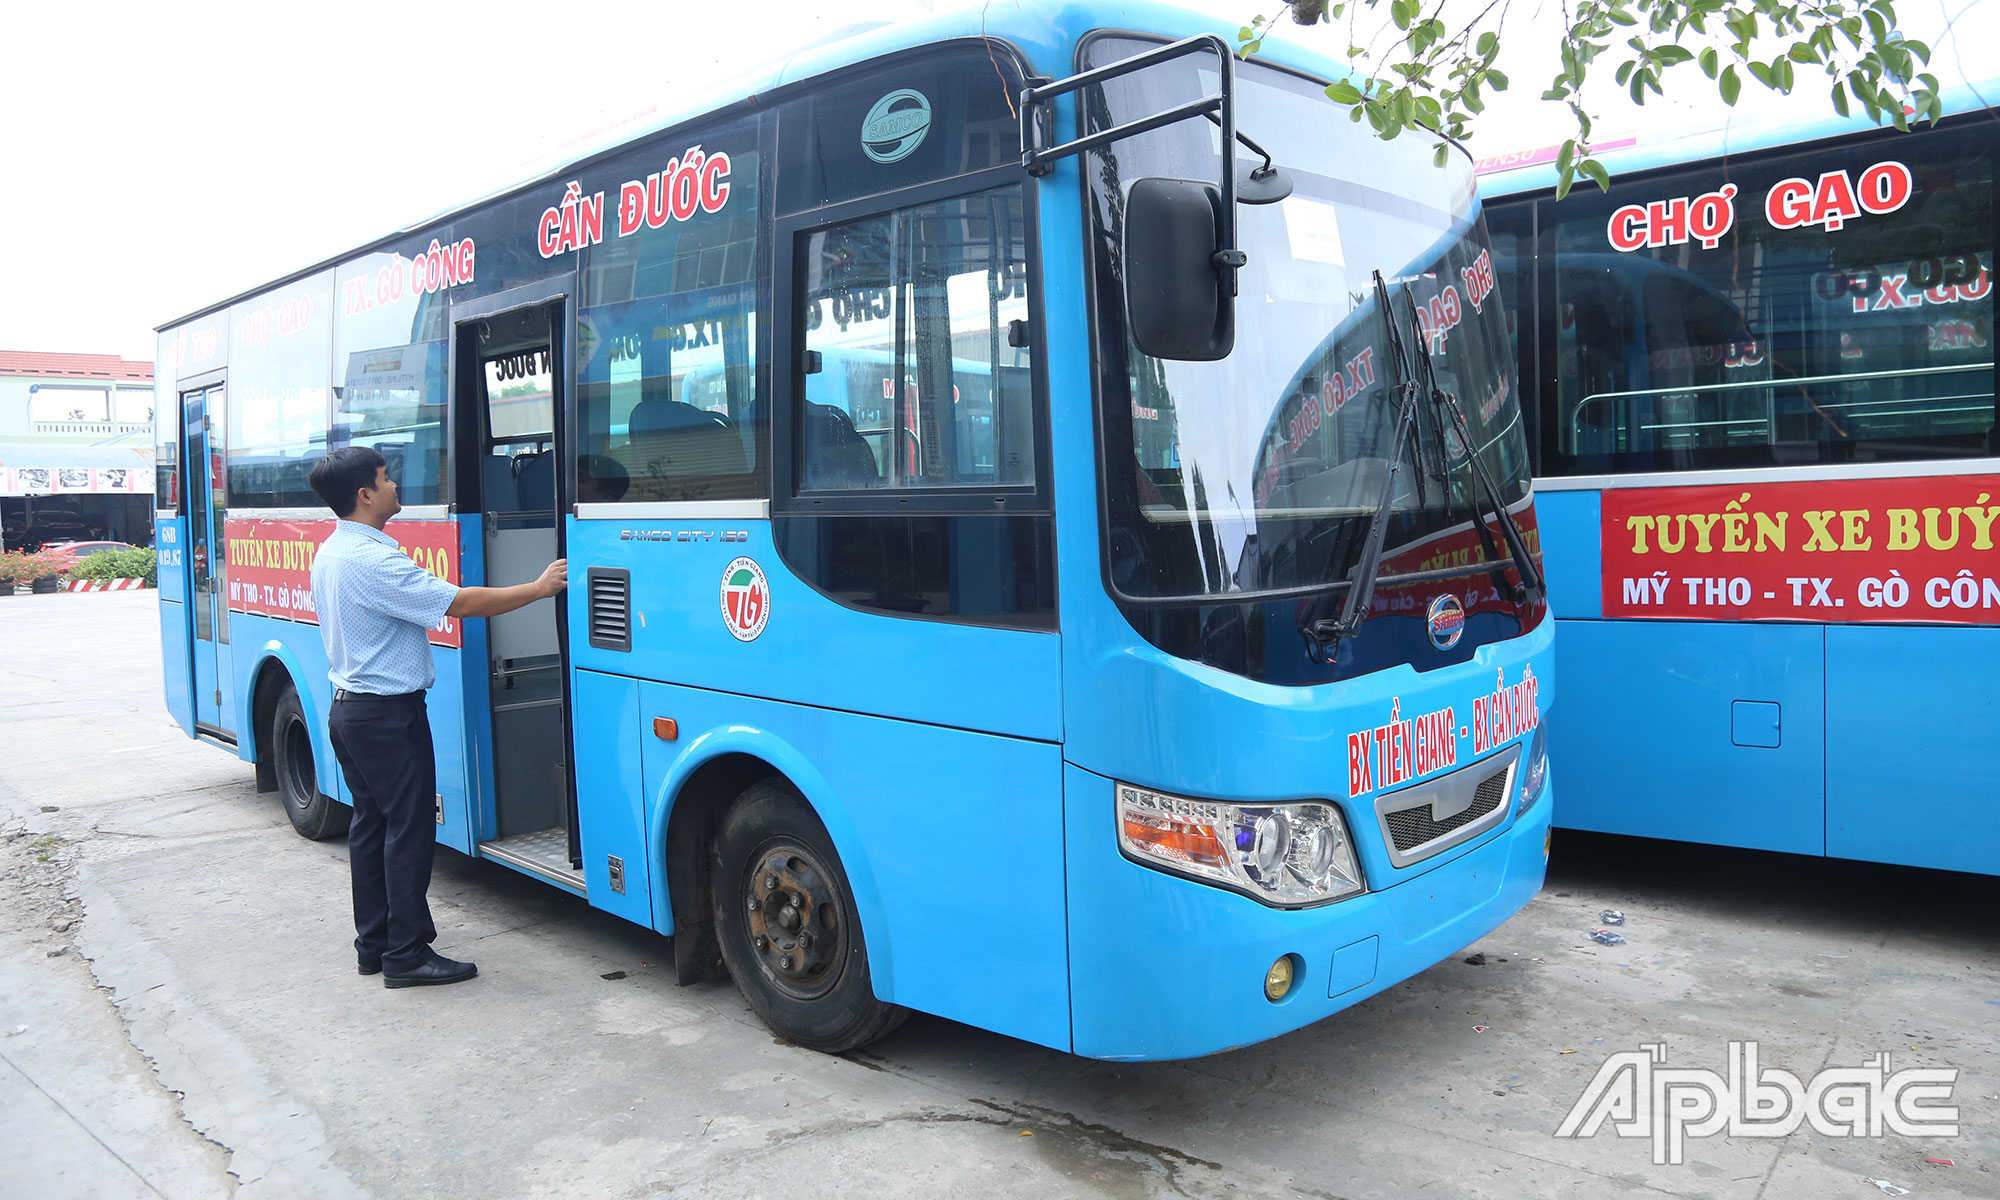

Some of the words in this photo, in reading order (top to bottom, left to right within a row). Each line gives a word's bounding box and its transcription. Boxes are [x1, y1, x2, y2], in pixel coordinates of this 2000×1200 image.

[868, 111, 923, 141] SAMCO
[538, 180, 605, 259] CẦN
[618, 144, 732, 238] ĐƯỚC
[1607, 182, 1738, 253] CHỢ
[1764, 160, 1913, 233] GẠO
[411, 238, 476, 296] CÔNG
[241, 301, 274, 349] CHỢ
[279, 293, 312, 341] GẠO
[229, 525, 264, 568] TUYẾN
[265, 539, 281, 569] XE
[282, 532, 315, 572] BUÝT
[620, 529, 673, 543] SAMCO
[677, 530, 715, 543] CITY
[1626, 492, 1789, 554] TUYẾN
[1802, 508, 1872, 553] XE
[230, 577, 241, 602] MỸ
[242, 582, 258, 604] THO
[263, 585, 277, 607] TX.
[278, 581, 290, 609] GÒ
[291, 583, 316, 613] CÔNG
[1623, 570, 1670, 606] MỸ
[1682, 577, 1752, 607] THO
[1786, 577, 1844, 607] TX.
[1858, 569, 1910, 607] GÒ
[1347, 729, 1373, 798] BX
[1374, 697, 1413, 789] TIỀN
[1415, 706, 1457, 778] GIANG
[1473, 693, 1490, 756] BX
[1490, 667, 1513, 748] CẦN
[1513, 662, 1540, 739] ĐƯỚC
